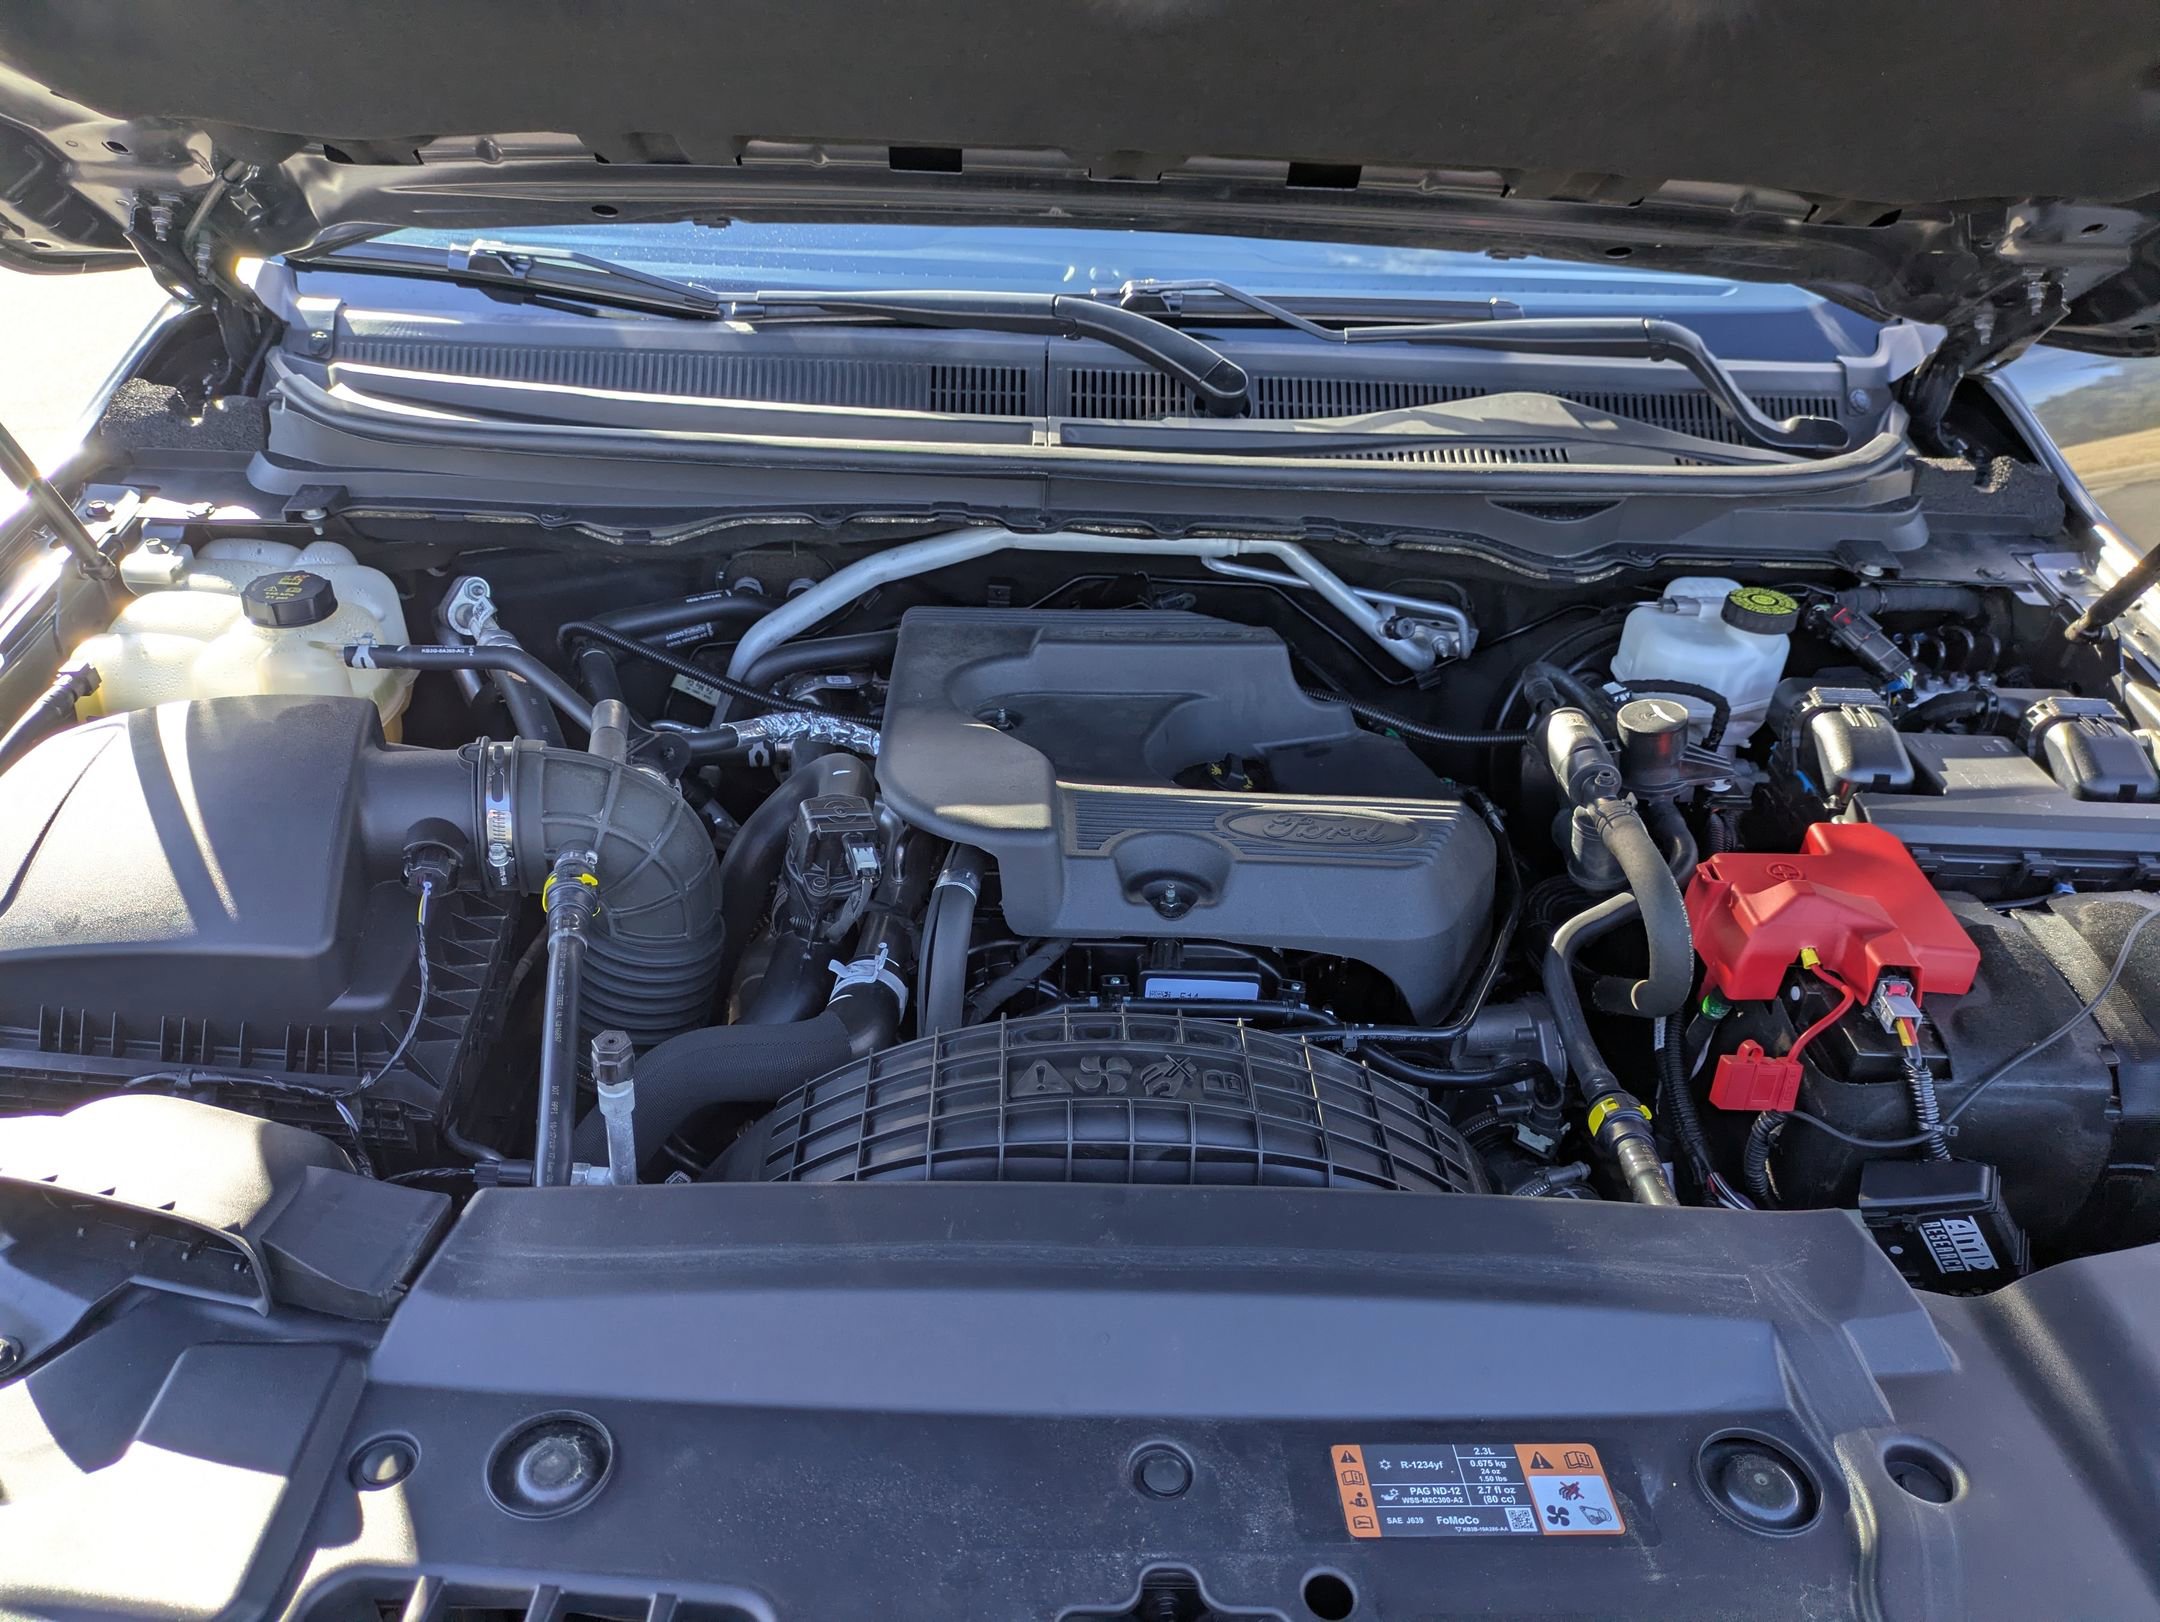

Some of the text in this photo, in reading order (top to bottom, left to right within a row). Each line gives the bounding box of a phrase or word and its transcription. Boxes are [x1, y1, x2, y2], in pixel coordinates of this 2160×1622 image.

[1262, 813, 1386, 843] Ford
[1921, 1221, 1965, 1272] RESEARCH
[1473, 1447, 1495, 1455] 2.3L
[1400, 1460, 1444, 1471] R-1234yf
[1469, 1459, 1507, 1469] 0.675 kg
[1409, 1486, 1462, 1496] PAG ND-12
[1477, 1486, 1492, 1494] 2.7
[1494, 1486, 1502, 1494] fl
[1483, 1495, 1516, 1505] (80 cc)
[1386, 1516, 1404, 1524] SAE
[1436, 1515, 1480, 1525] FoMoCo
